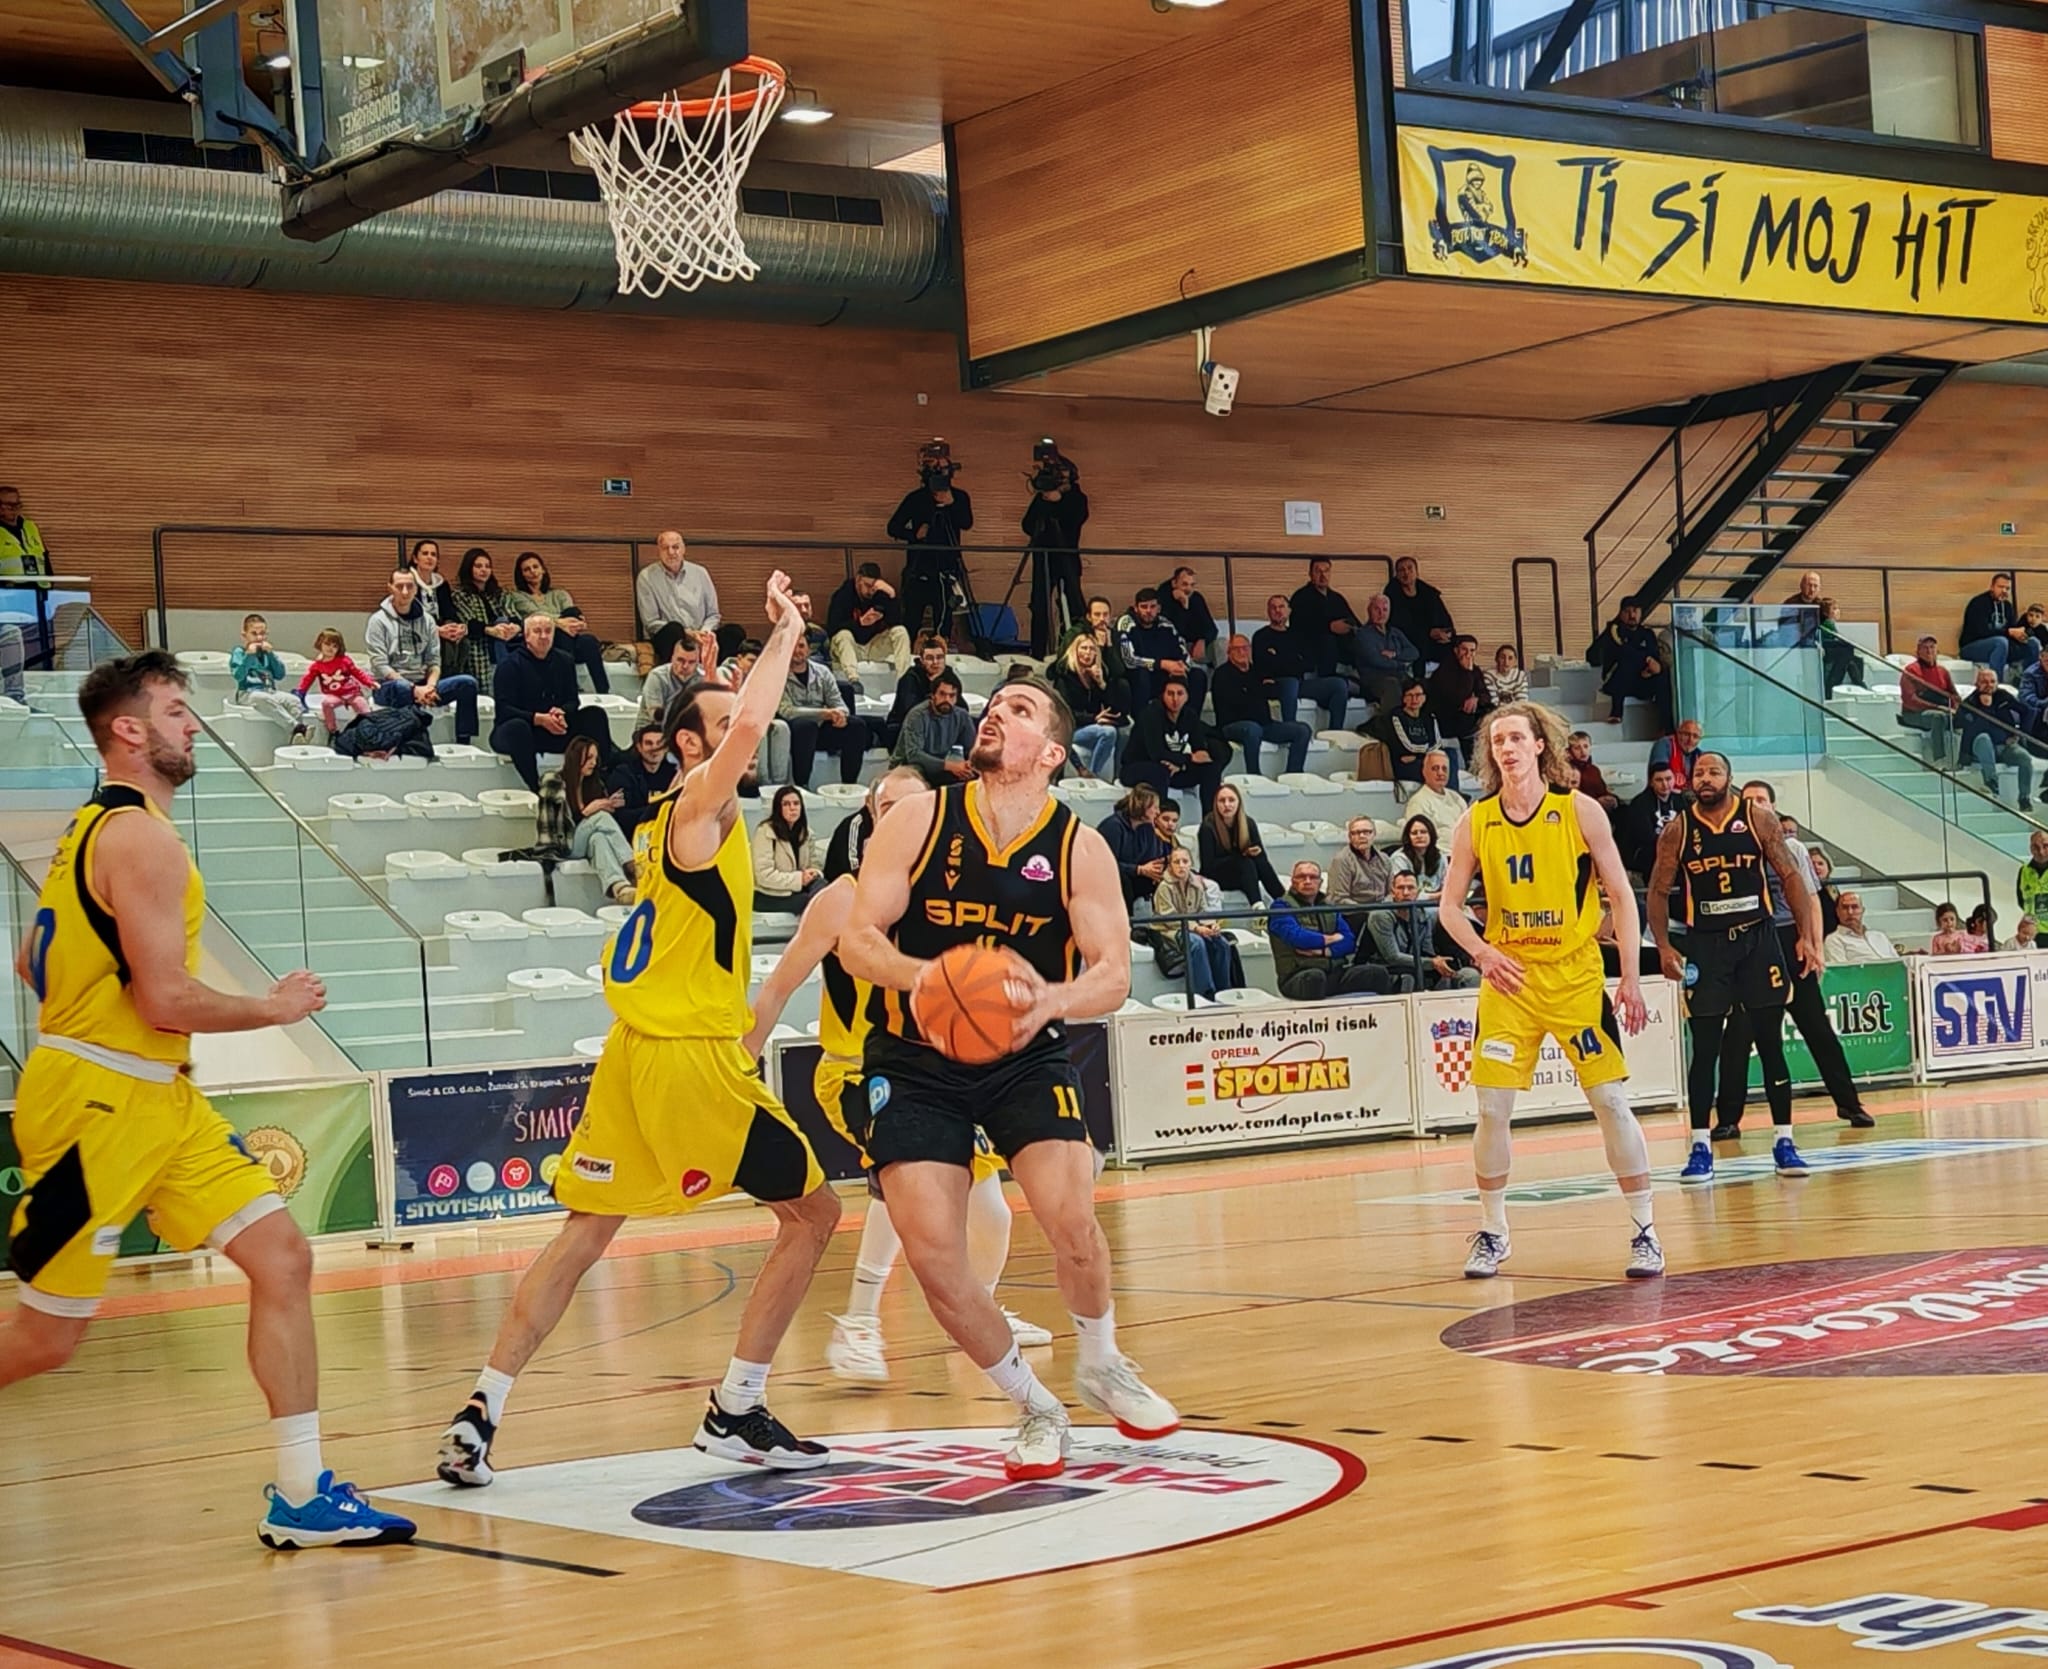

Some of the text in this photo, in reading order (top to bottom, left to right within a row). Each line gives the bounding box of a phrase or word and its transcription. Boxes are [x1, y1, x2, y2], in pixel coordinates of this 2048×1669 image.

[1740, 192, 1871, 283] MOJ
[1506, 854, 1533, 884] 14
[1687, 854, 1756, 874] SPLIT
[1719, 872, 1732, 893] 2
[925, 899, 1053, 936] SPLIT
[1769, 966, 1784, 988] 2
[1336, 1013, 1378, 1033] tisak
[1211, 1047, 1260, 1060] OPREMA
[1570, 1027, 1602, 1061] 14
[1216, 1058, 1350, 1100] ŠPOLJAR
[1053, 1085, 1082, 1120] 11
[514, 1097, 580, 1143] ŠIMIĆ
[406, 1189, 556, 1219] SITOTISAK I DIG
